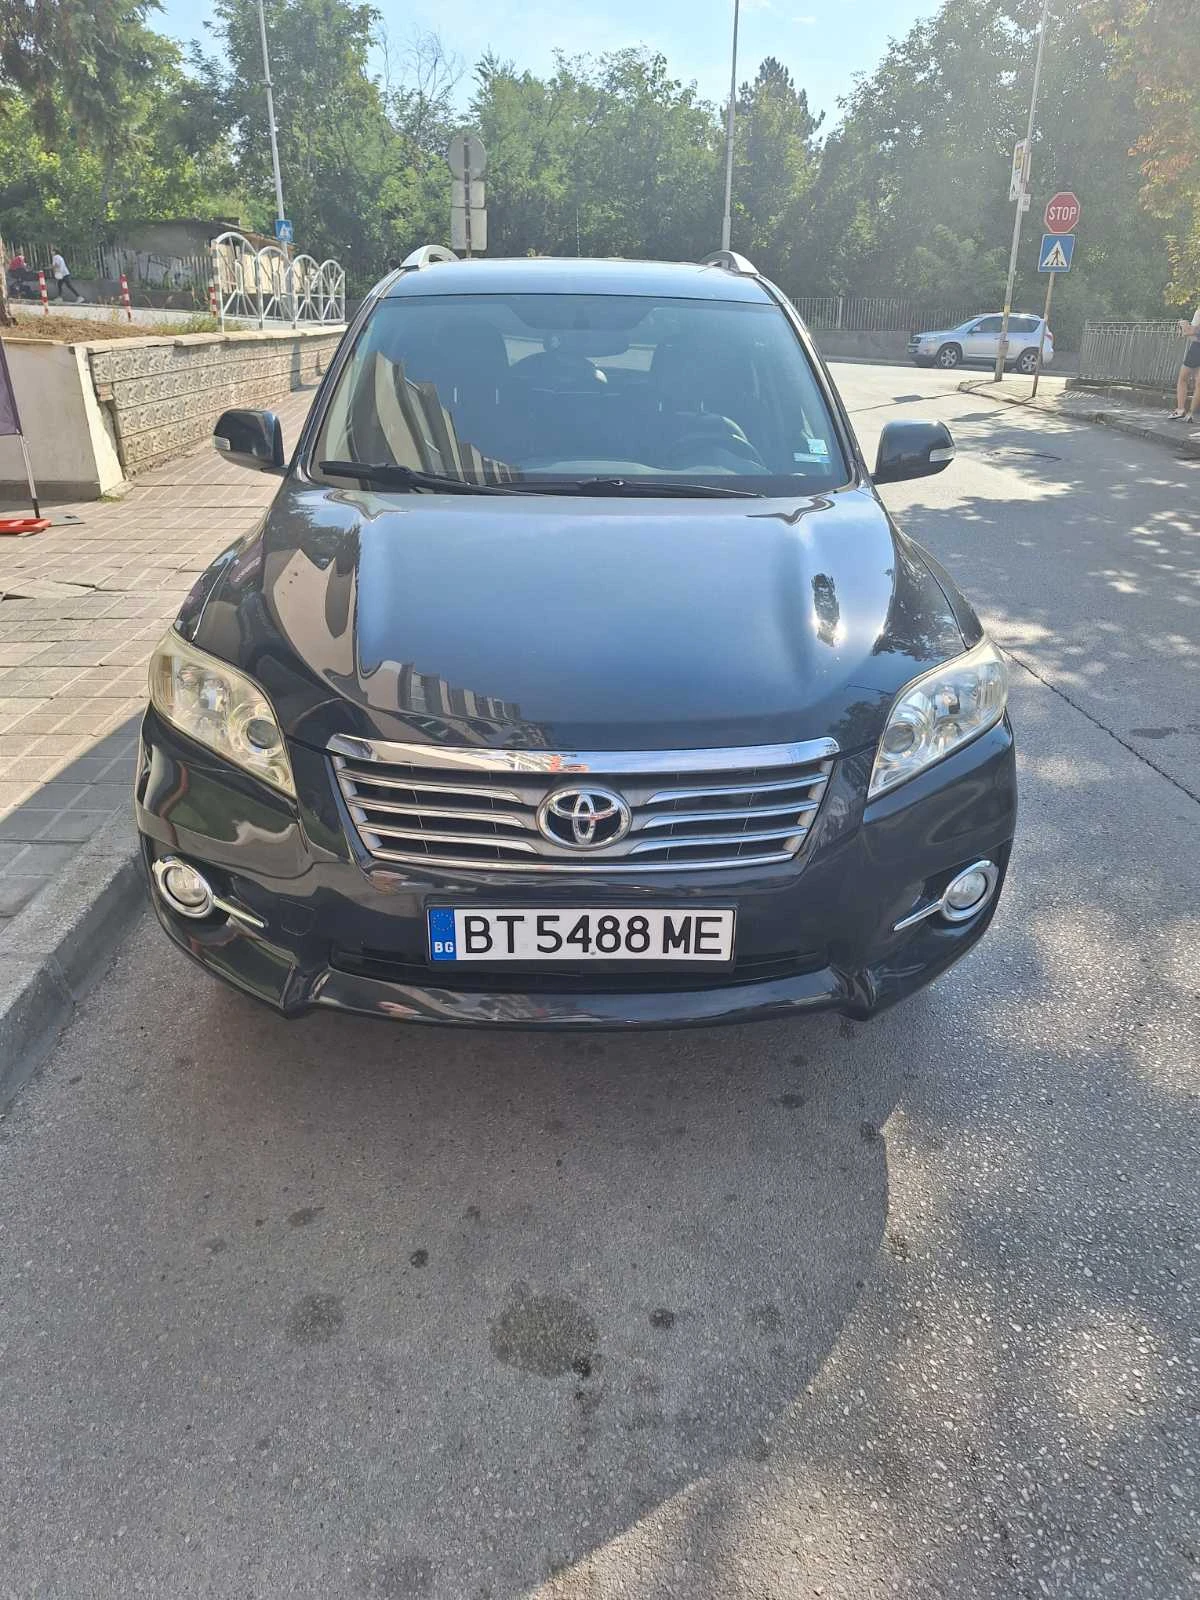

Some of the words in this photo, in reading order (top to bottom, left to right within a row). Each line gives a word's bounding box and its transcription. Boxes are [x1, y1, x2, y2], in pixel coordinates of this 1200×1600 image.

[1049, 206, 1077, 220] STOP
[464, 915, 525, 954] BT
[536, 914, 651, 954] 5488
[662, 915, 723, 954] ME
[434, 941, 454, 953] BG
